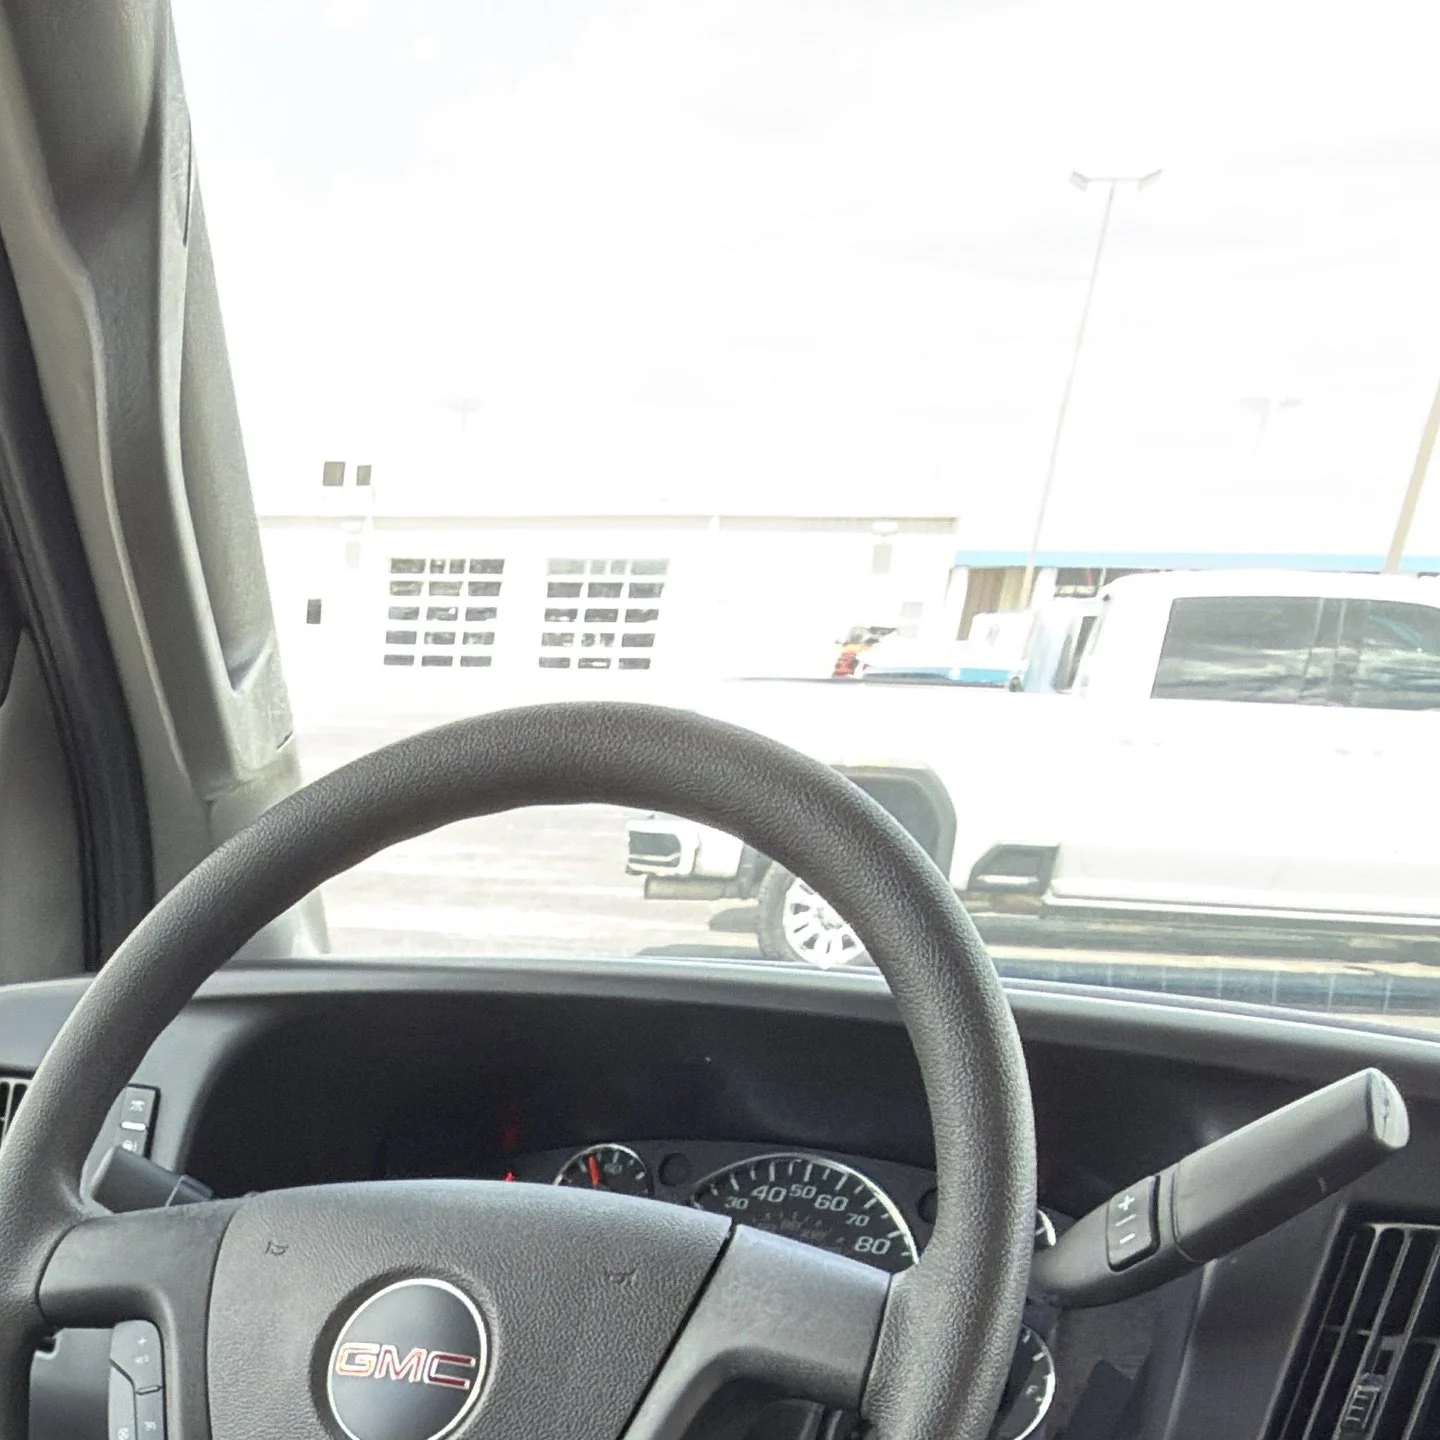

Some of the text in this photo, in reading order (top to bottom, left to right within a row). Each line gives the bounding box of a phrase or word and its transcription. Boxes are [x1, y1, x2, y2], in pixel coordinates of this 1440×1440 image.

[751, 1185, 786, 1202] 40
[789, 1184, 817, 1199] 50
[725, 1196, 748, 1209] 30
[815, 1194, 848, 1211] 60
[845, 1212, 869, 1227] 70
[854, 1236, 891, 1254] 80
[335, 1342, 476, 1390] GMC
